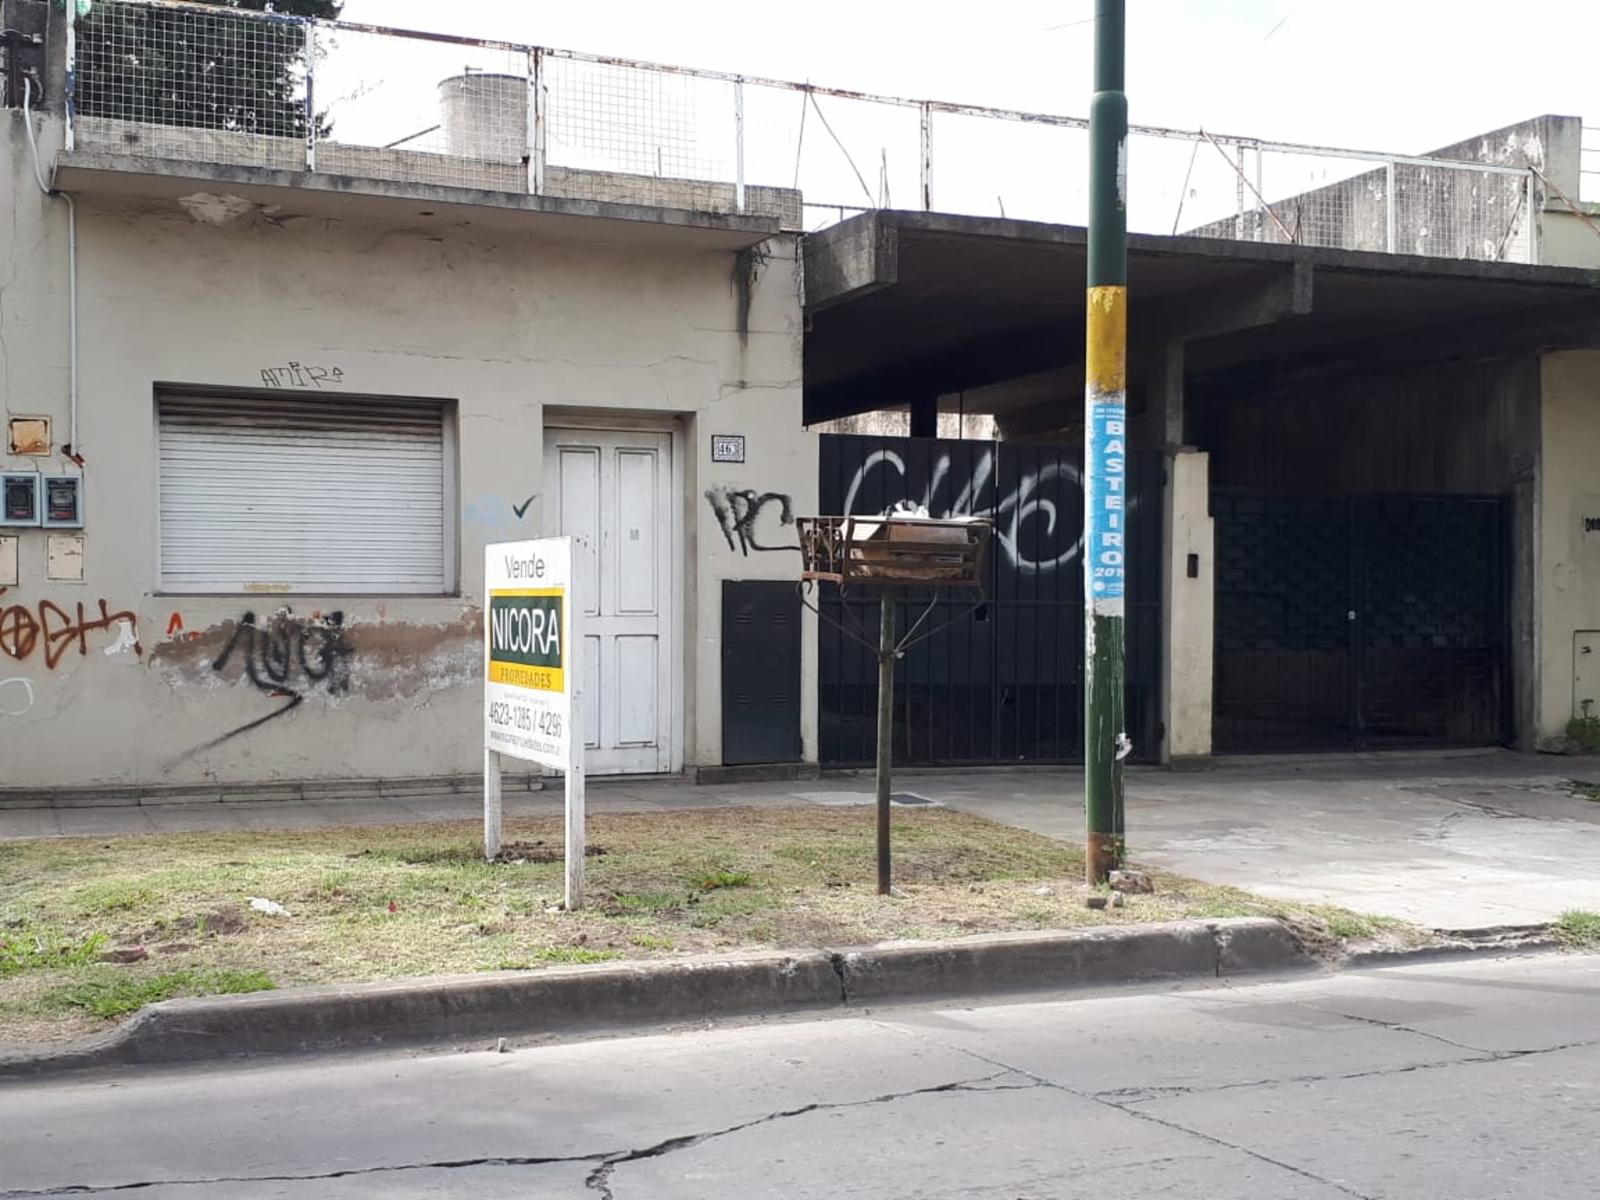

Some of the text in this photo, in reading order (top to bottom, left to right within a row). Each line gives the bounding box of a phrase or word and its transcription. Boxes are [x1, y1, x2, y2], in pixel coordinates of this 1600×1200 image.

[1102, 420, 1124, 565] BASTEIRO
[504, 552, 545, 578] Vende
[492, 607, 560, 655] NICORA
